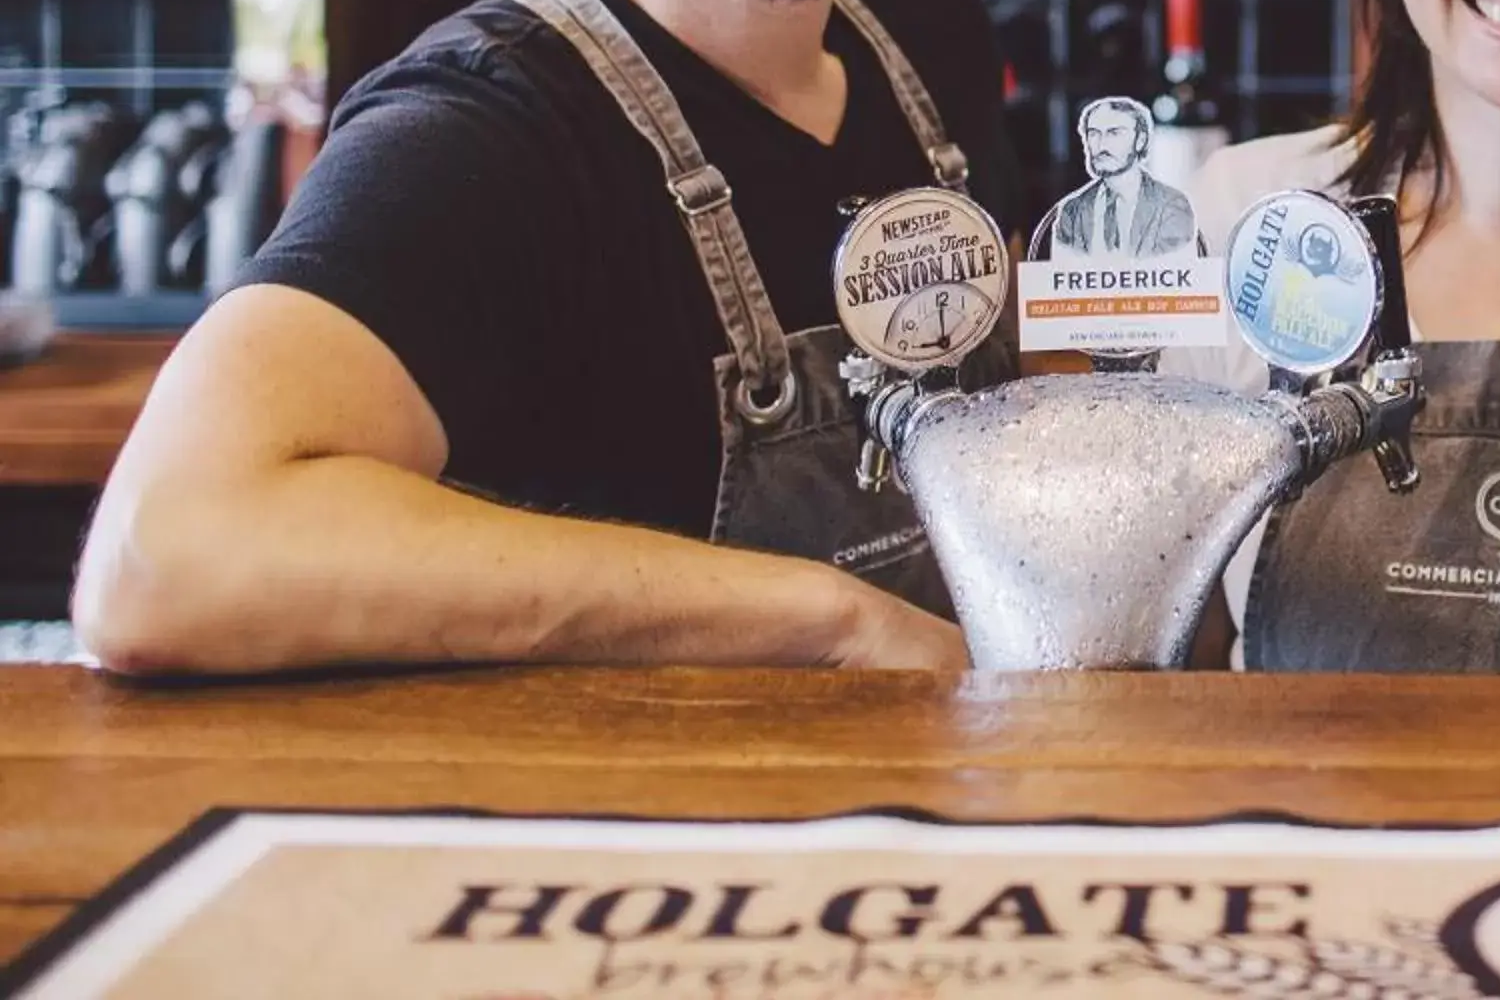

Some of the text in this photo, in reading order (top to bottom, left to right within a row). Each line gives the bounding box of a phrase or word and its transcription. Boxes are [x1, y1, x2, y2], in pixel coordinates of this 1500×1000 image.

[881, 209, 951, 243] NEWSTEAD
[859, 233, 979, 271] 3 Quarter Time
[1236, 200, 1289, 322] HOLGATE
[844, 244, 997, 307] SESSION ALE
[1053, 269, 1192, 291] FREDERICK
[935, 291, 949, 308] 12
[413, 880, 1313, 943] HOLGATE
